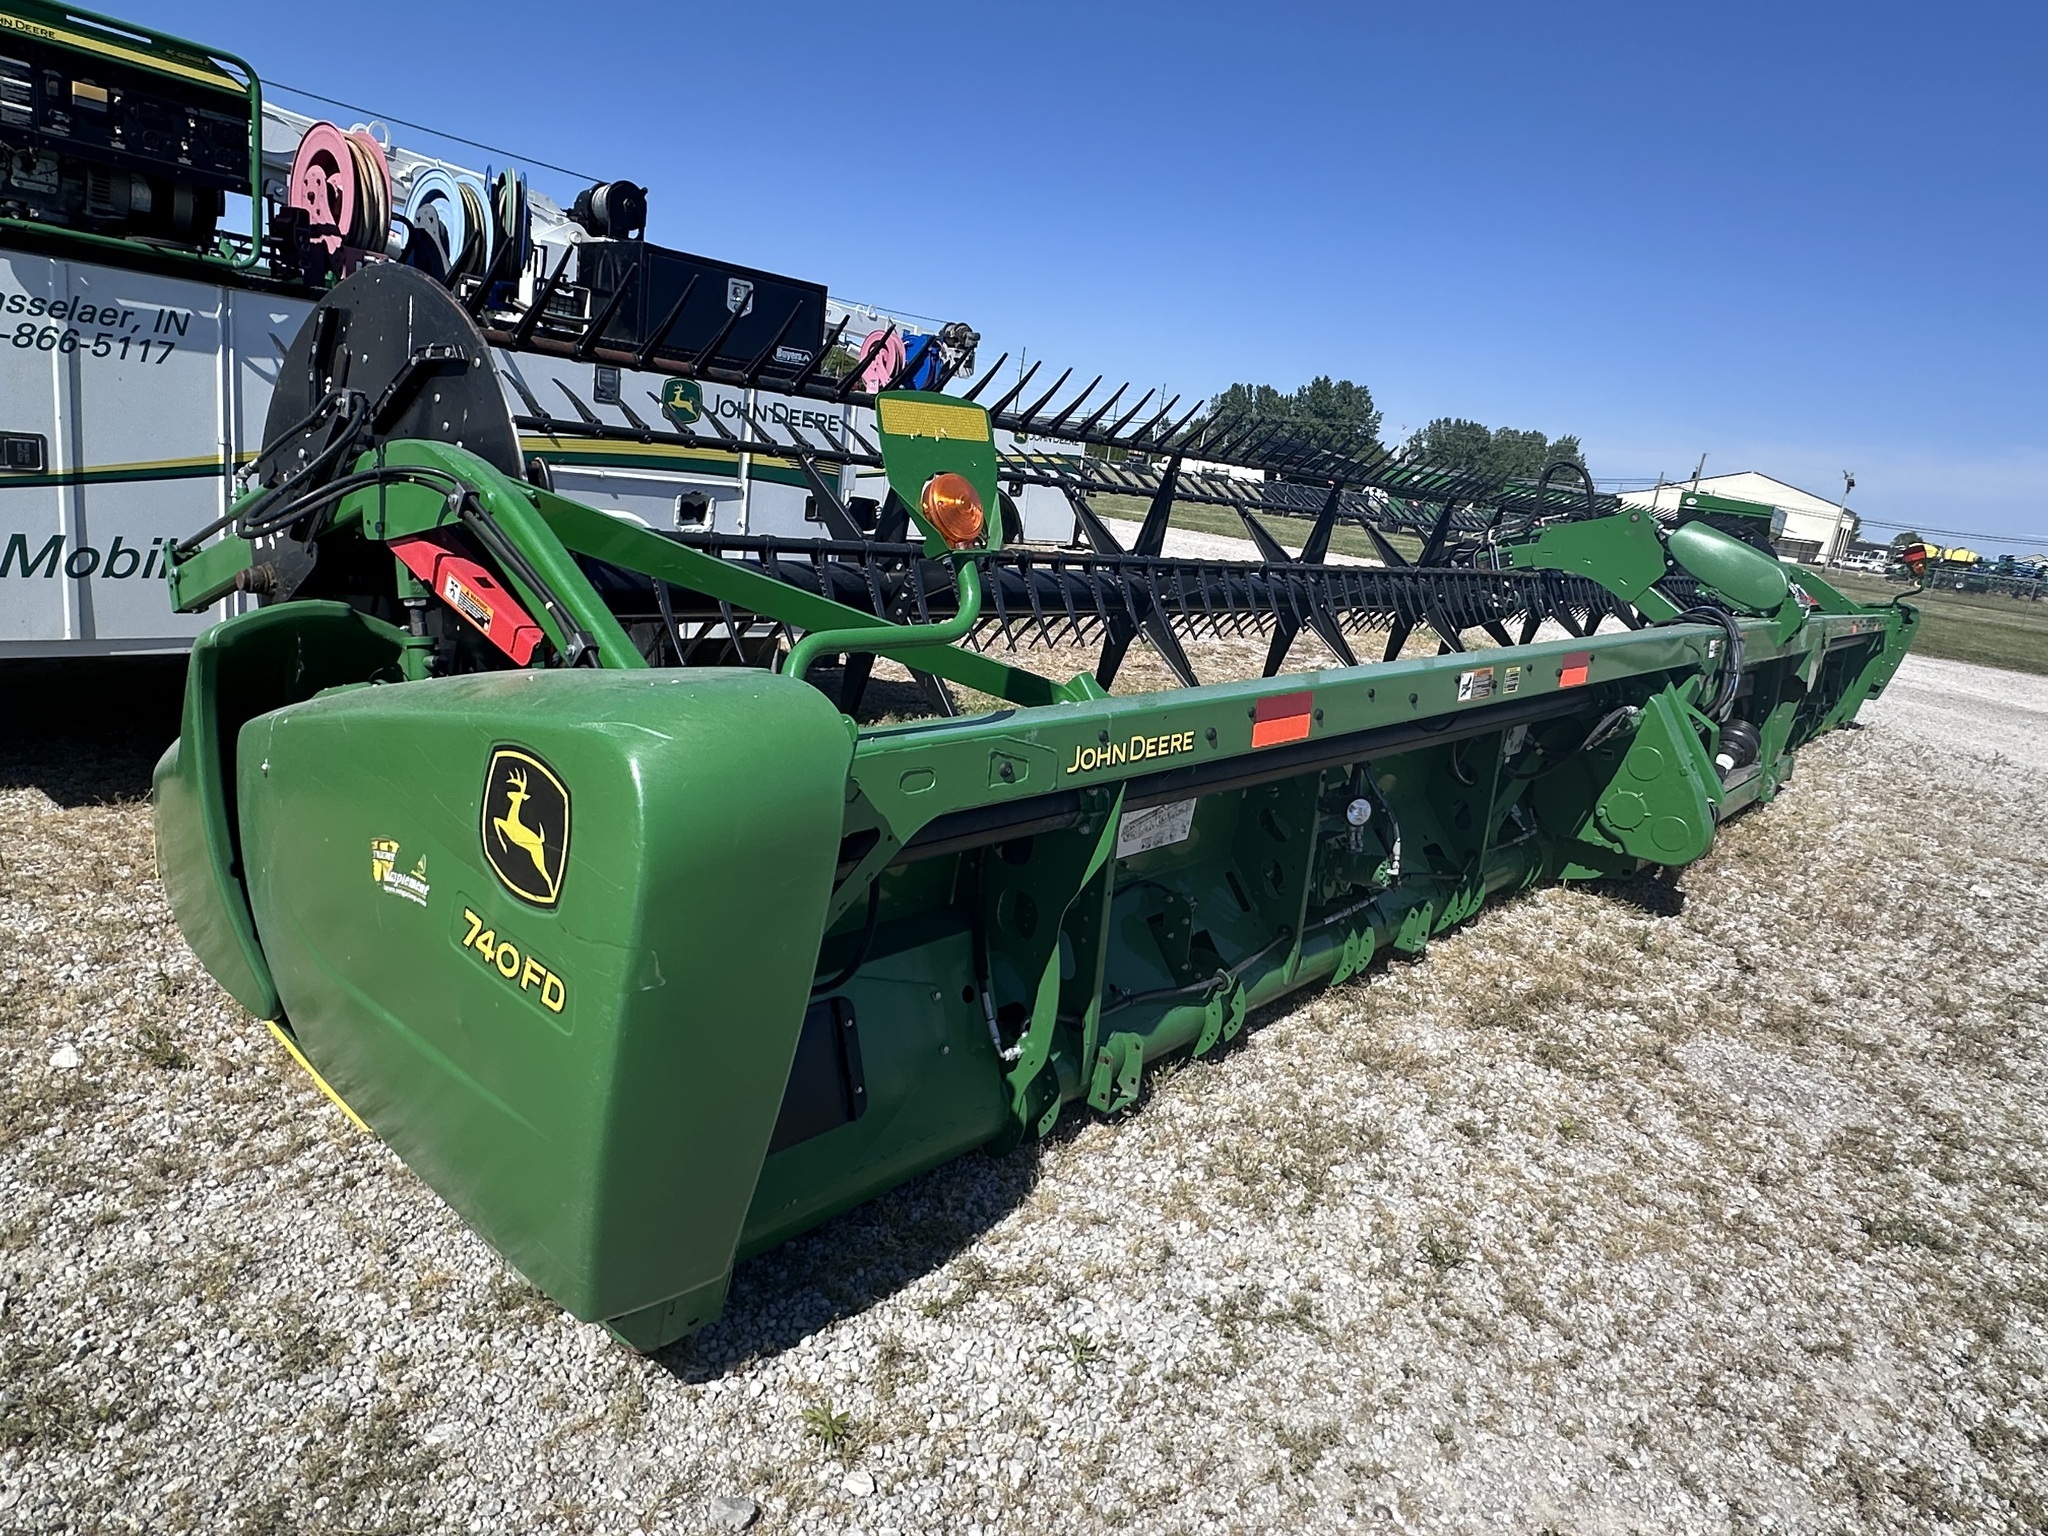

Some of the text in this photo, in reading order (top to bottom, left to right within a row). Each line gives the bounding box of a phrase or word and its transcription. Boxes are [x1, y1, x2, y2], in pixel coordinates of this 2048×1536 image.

[15, 20, 56, 39] DEERE
[153, 308, 191, 337] IN
[710, 394, 840, 432] JOHN DEERE
[1066, 731, 1195, 774] JOHN DEERE
[462, 906, 567, 1014] 740FD
